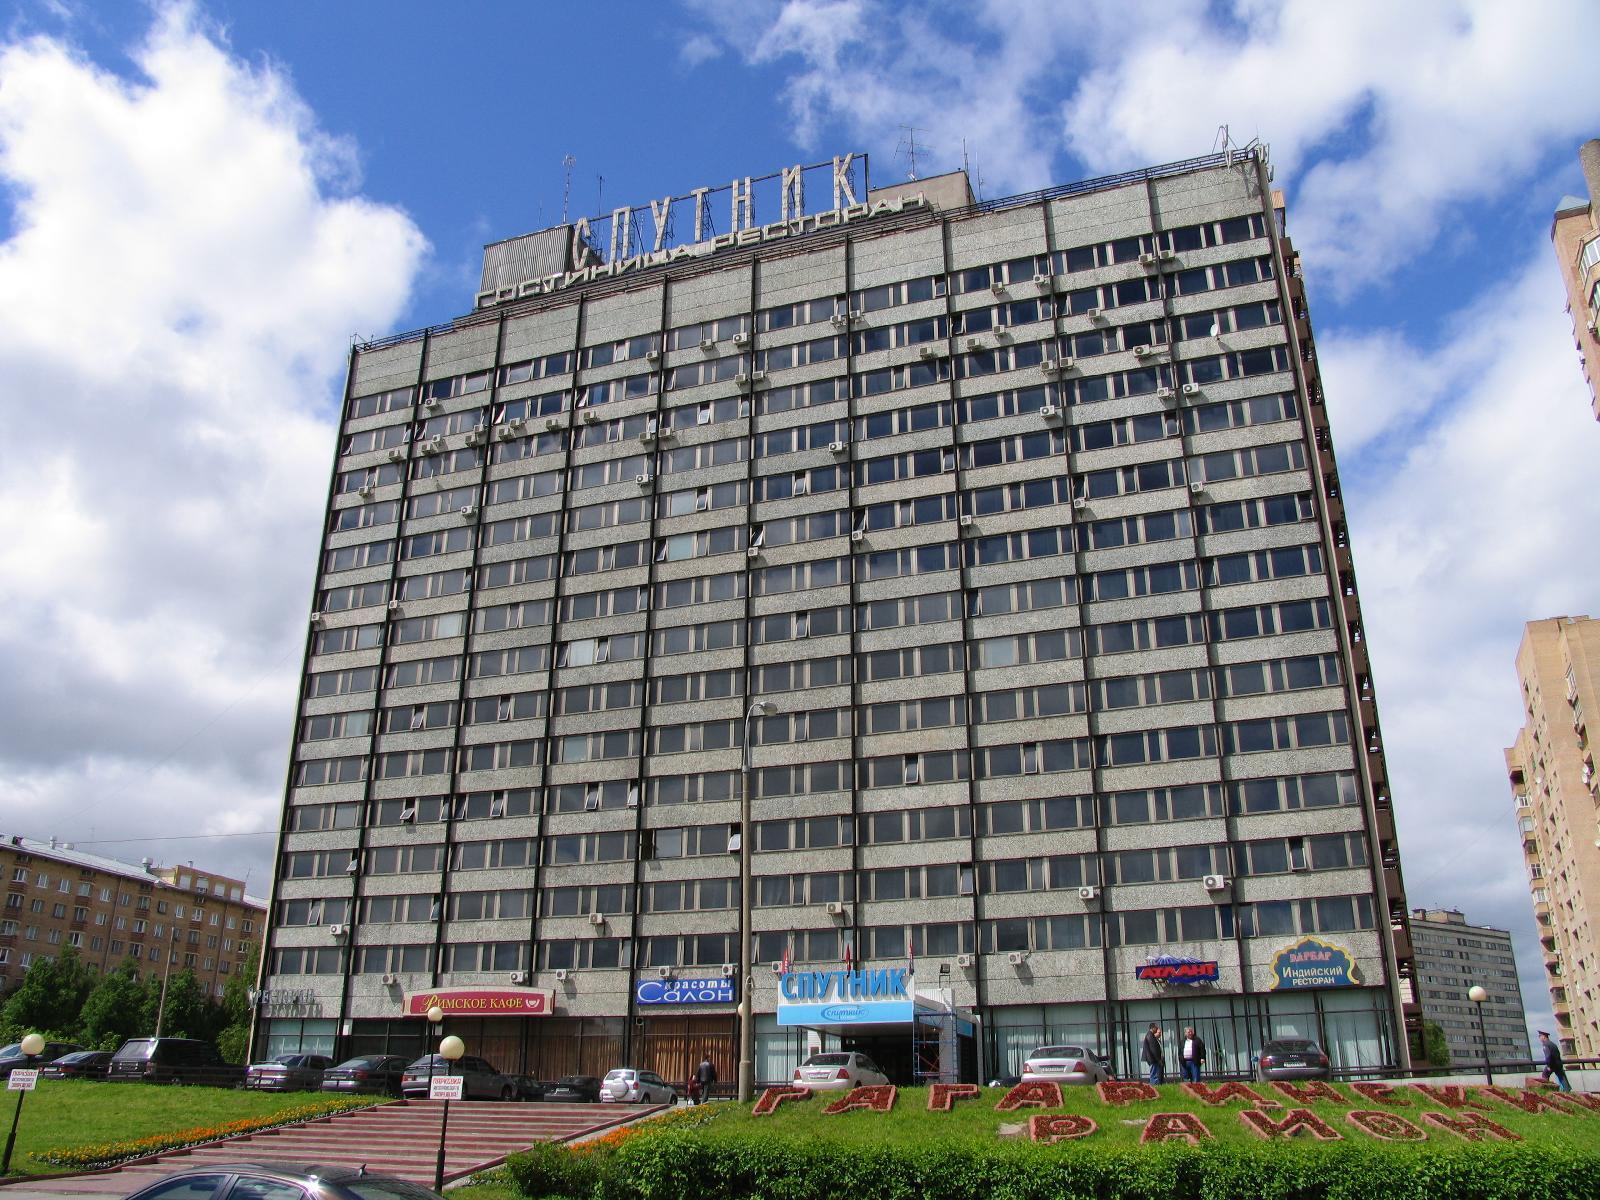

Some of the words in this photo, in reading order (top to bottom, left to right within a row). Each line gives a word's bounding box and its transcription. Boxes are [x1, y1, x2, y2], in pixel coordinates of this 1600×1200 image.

[571, 152, 857, 271] СПУТНИК
[711, 190, 925, 252] РЕСТОРАН
[1139, 963, 1217, 979] АТЛАНТ
[664, 980, 731, 991] красоты
[780, 967, 909, 1001] СПУТНИК
[1292, 976, 1335, 986] РЕСТОРАН
[637, 981, 733, 1002] Салон
[490, 998, 523, 1009] КАФЕ
[826, 1007, 866, 1021] спутник
[1030, 1103, 1524, 1145] РАЙОН
